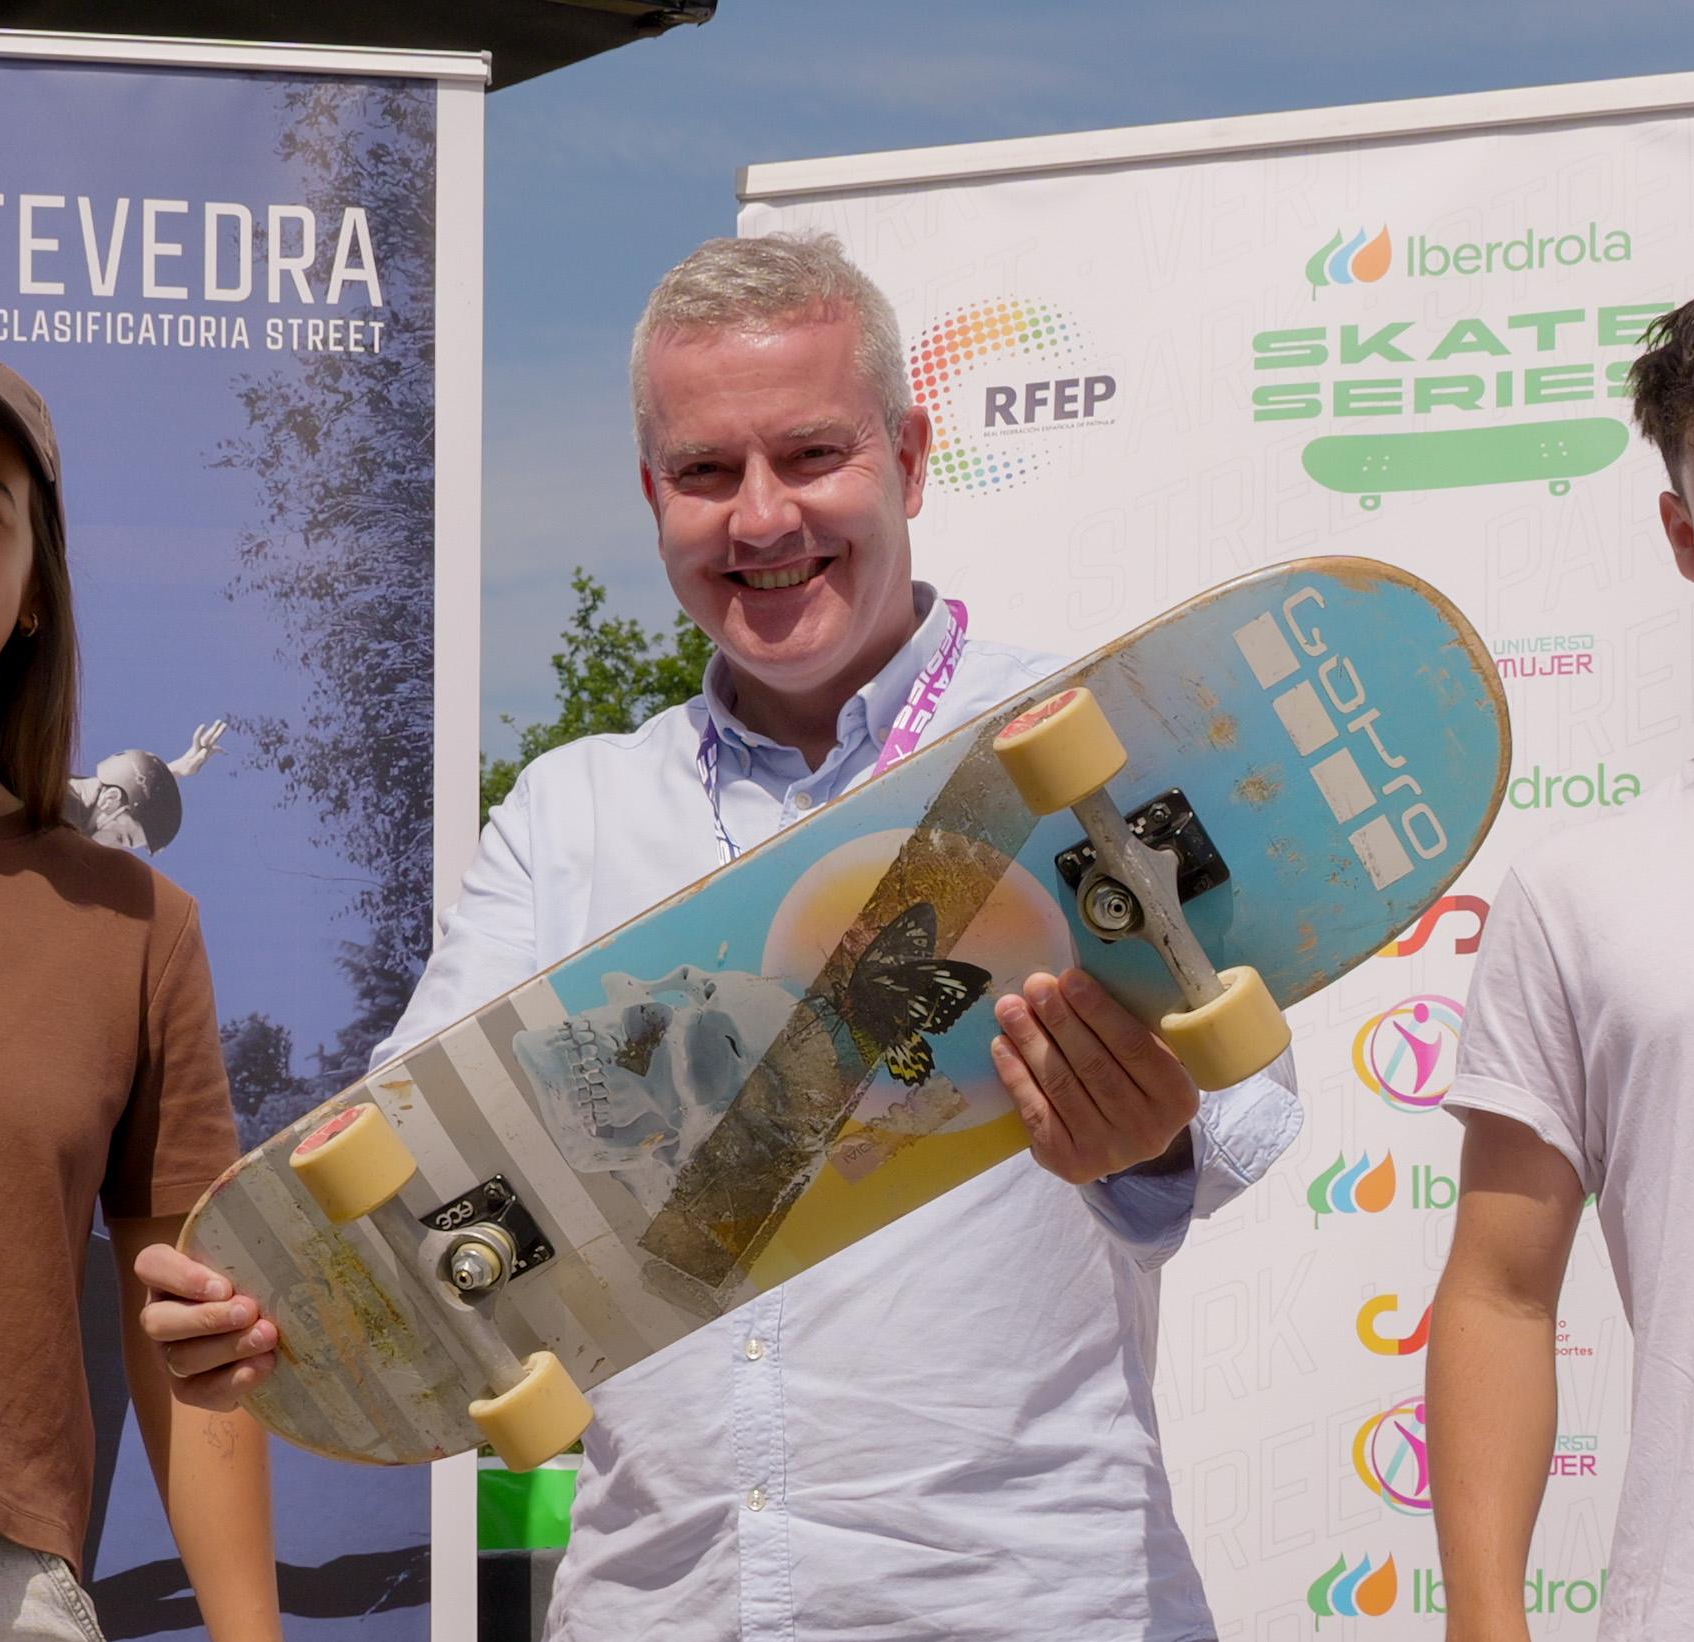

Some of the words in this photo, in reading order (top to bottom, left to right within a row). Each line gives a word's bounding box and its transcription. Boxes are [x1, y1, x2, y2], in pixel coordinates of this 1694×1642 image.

[1407, 222, 1632, 277] Iberdrola
[265, 318, 385, 354] STREET
[1252, 302, 1675, 370] SKATE
[984, 375, 1116, 428] RFEP
[1493, 634, 1595, 654] UNIVERSO
[1496, 654, 1594, 679] MUJER
[1508, 763, 1641, 810] drola
